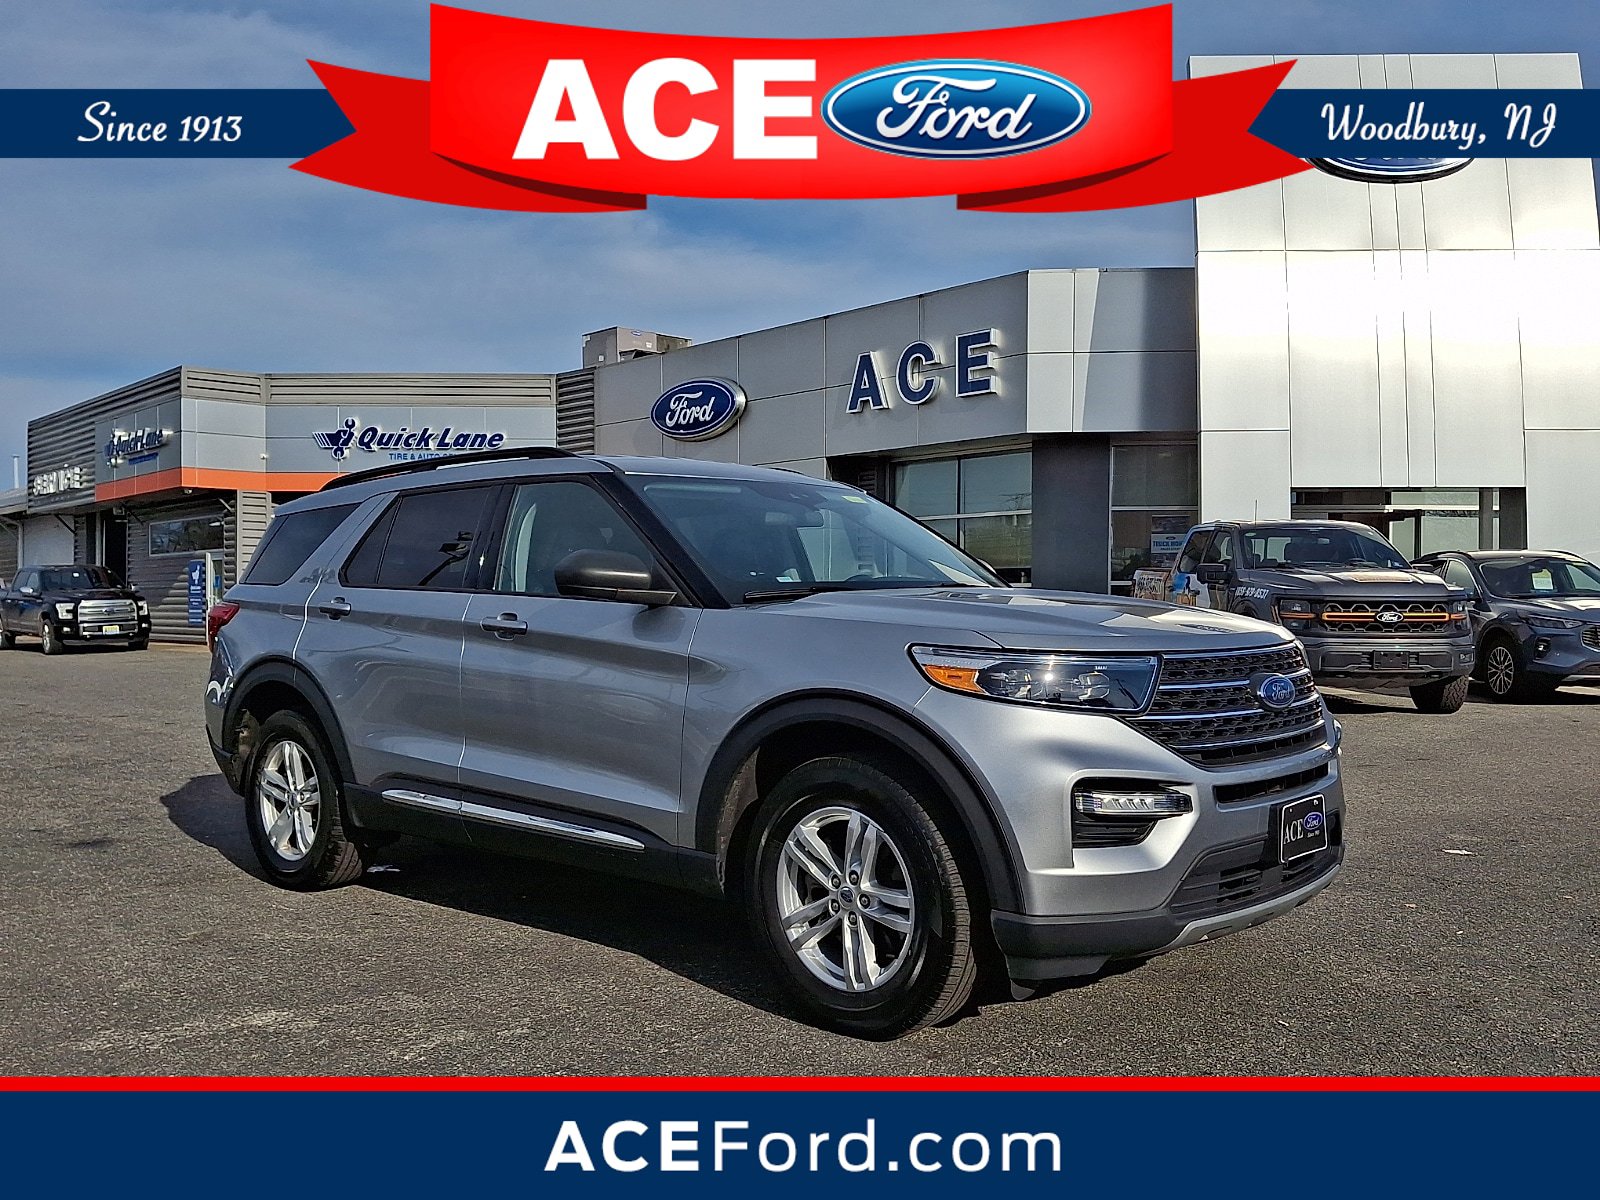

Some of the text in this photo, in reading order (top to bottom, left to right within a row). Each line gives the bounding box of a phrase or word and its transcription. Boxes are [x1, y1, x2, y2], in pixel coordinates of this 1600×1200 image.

[846, 327, 999, 414] ACE
[665, 391, 716, 428] Ford
[357, 426, 505, 451] Quick Lane
[388, 453, 409, 461] TIRE
[1271, 682, 1291, 701] Ford
[1283, 818, 1304, 845] ACE
